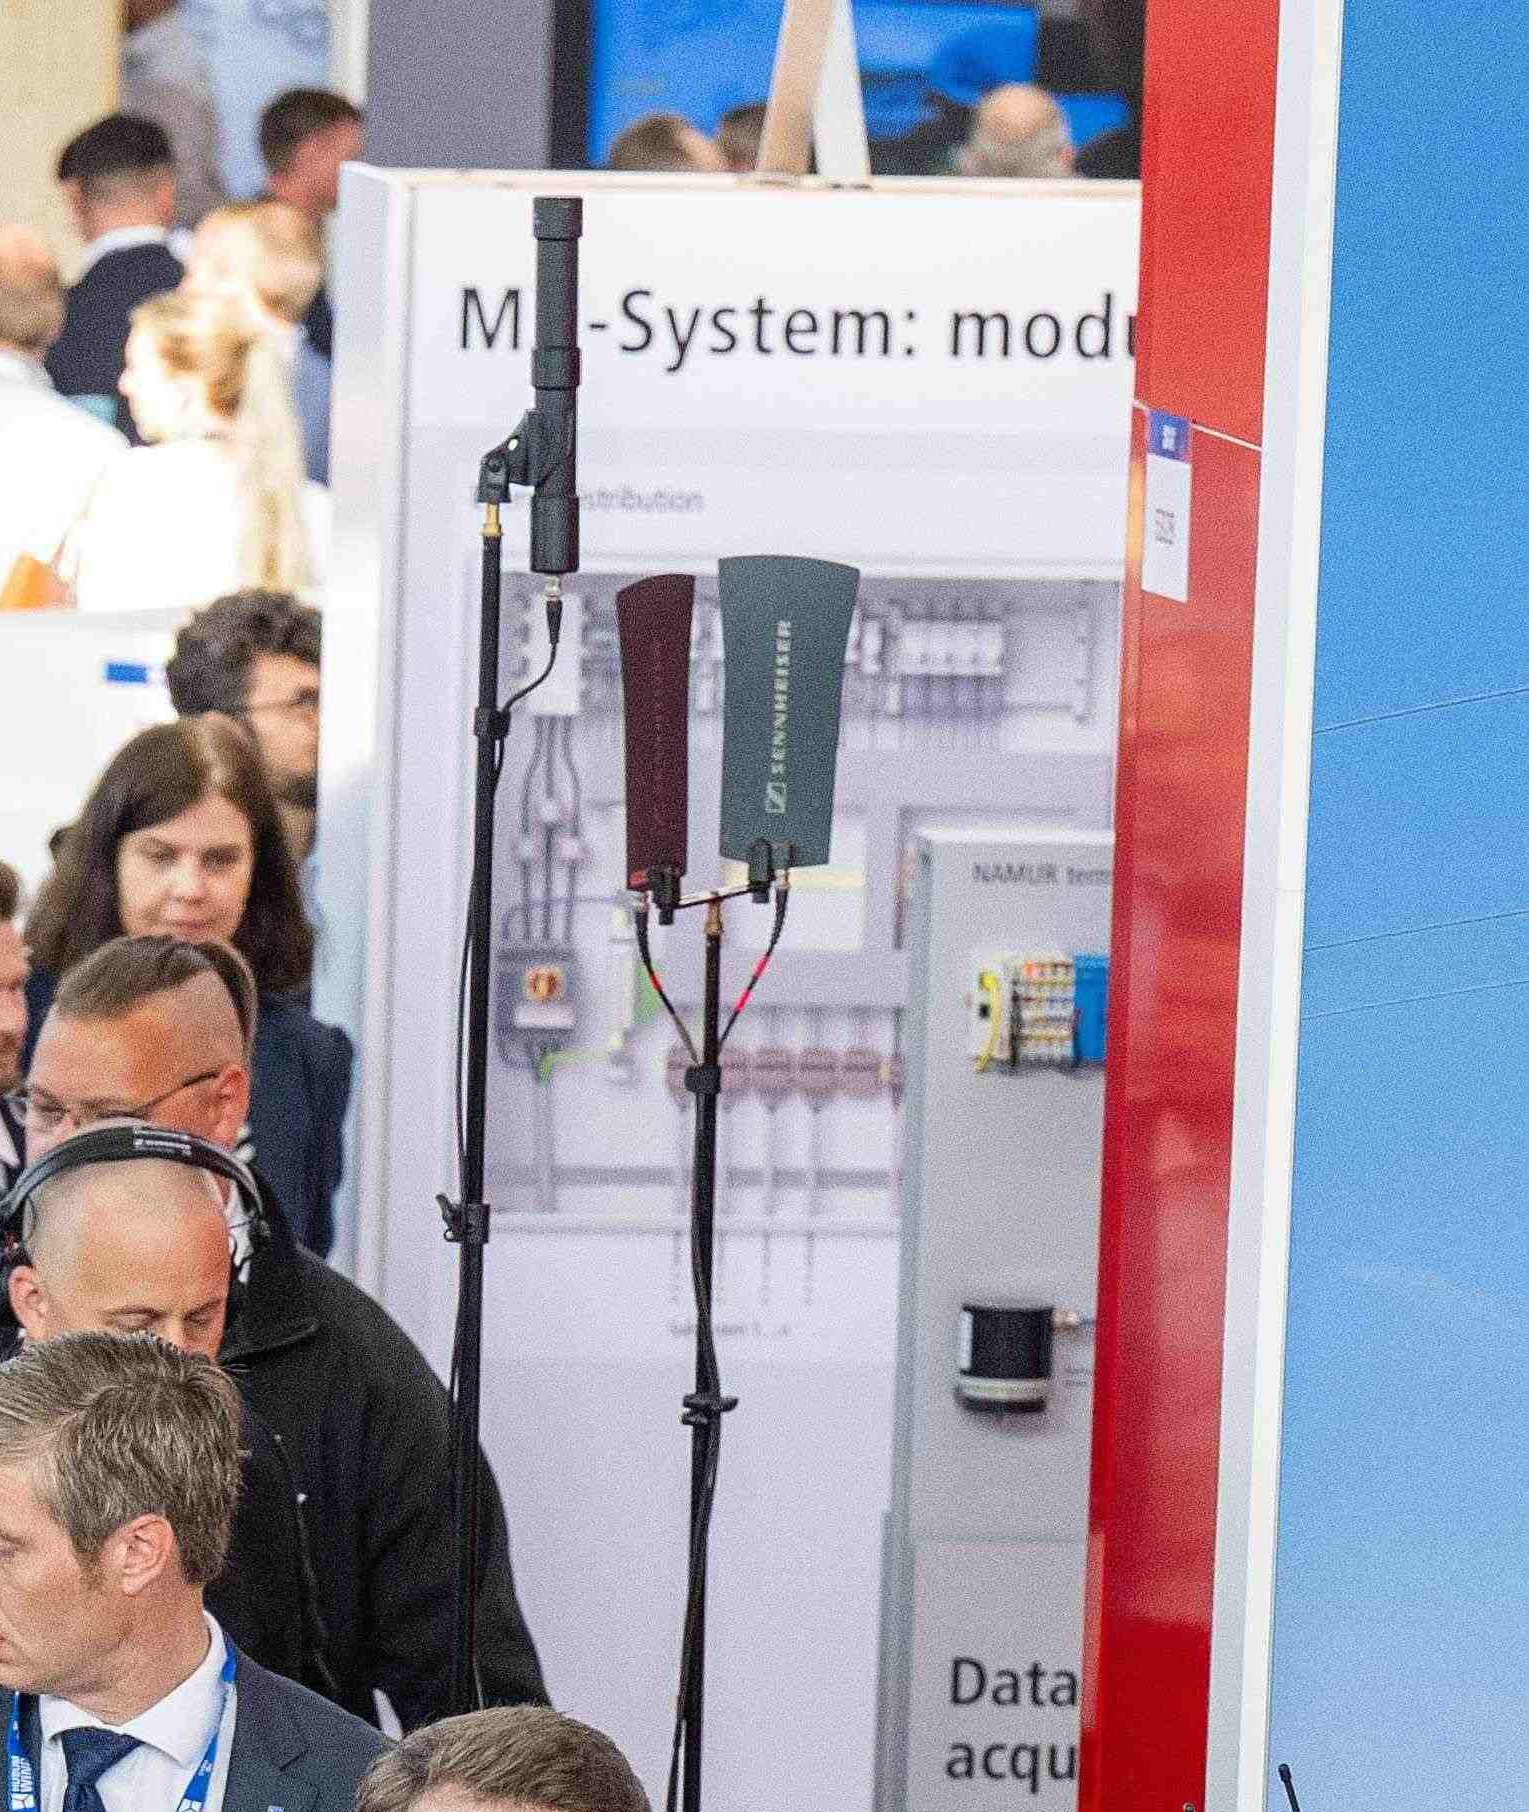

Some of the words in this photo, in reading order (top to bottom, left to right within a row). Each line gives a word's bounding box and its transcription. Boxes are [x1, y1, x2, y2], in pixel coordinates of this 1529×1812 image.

[460, 286, 916, 373] M-System:
[949, 292, 1138, 359] mod
[950, 1656, 1079, 1706] Data
